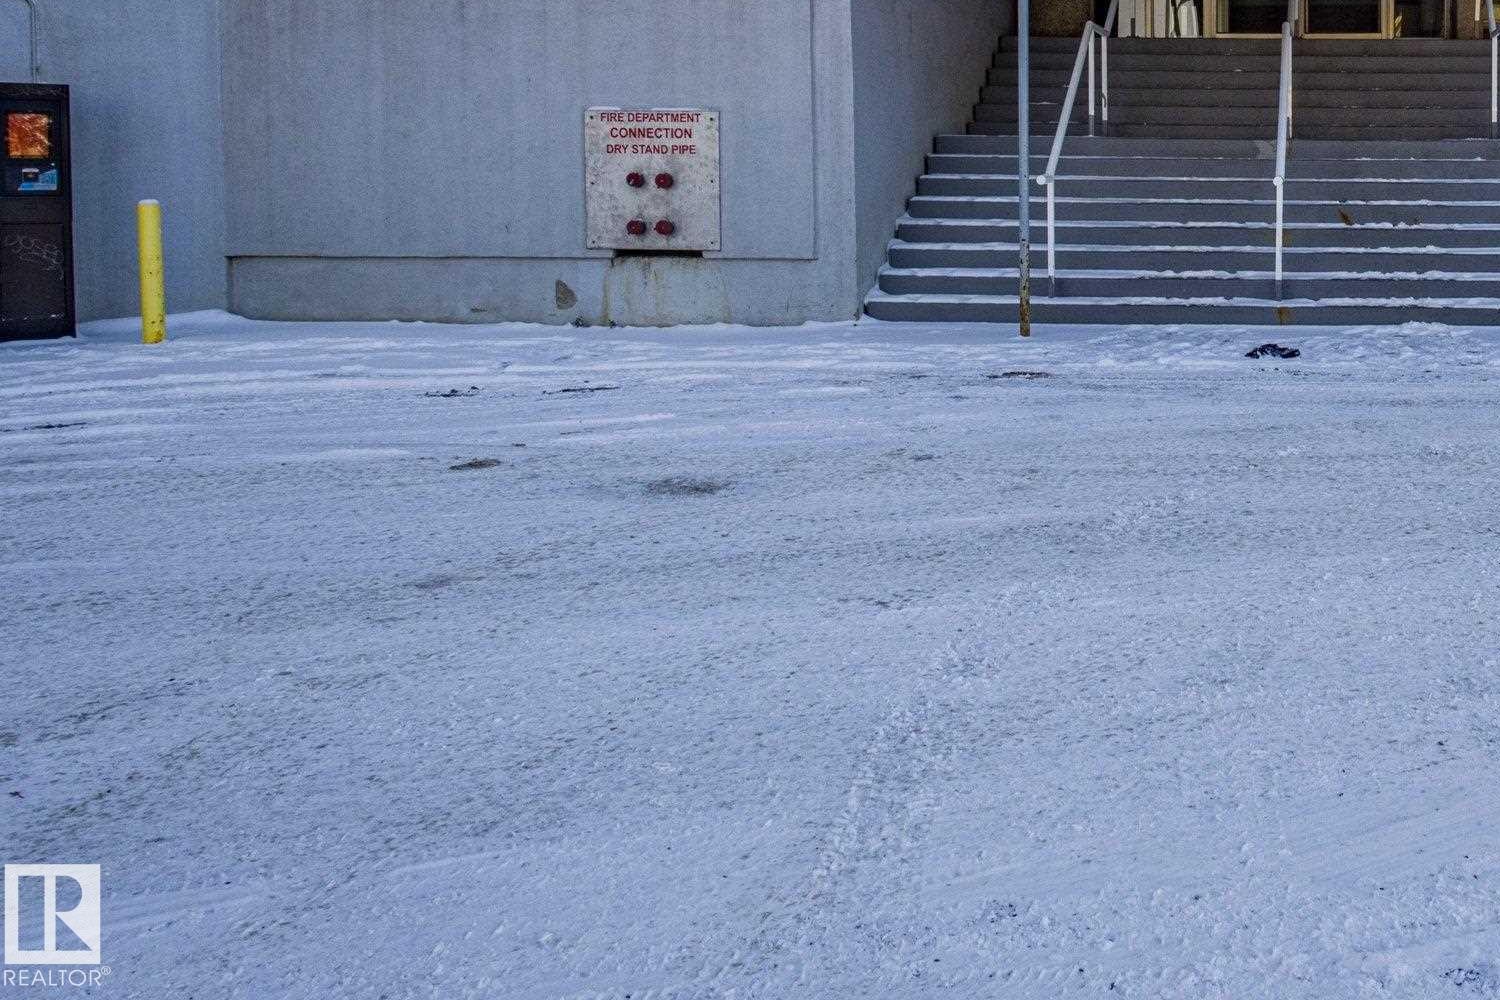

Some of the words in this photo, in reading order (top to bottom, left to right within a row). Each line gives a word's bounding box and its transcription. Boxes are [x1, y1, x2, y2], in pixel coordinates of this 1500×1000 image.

[600, 112, 624, 122] FIRE
[627, 112, 701, 123] DEPARTMENT
[610, 127, 693, 139] CONNECTION
[606, 144, 628, 154] DRY
[631, 144, 668, 154] STAND
[671, 144, 696, 155] PIPE
